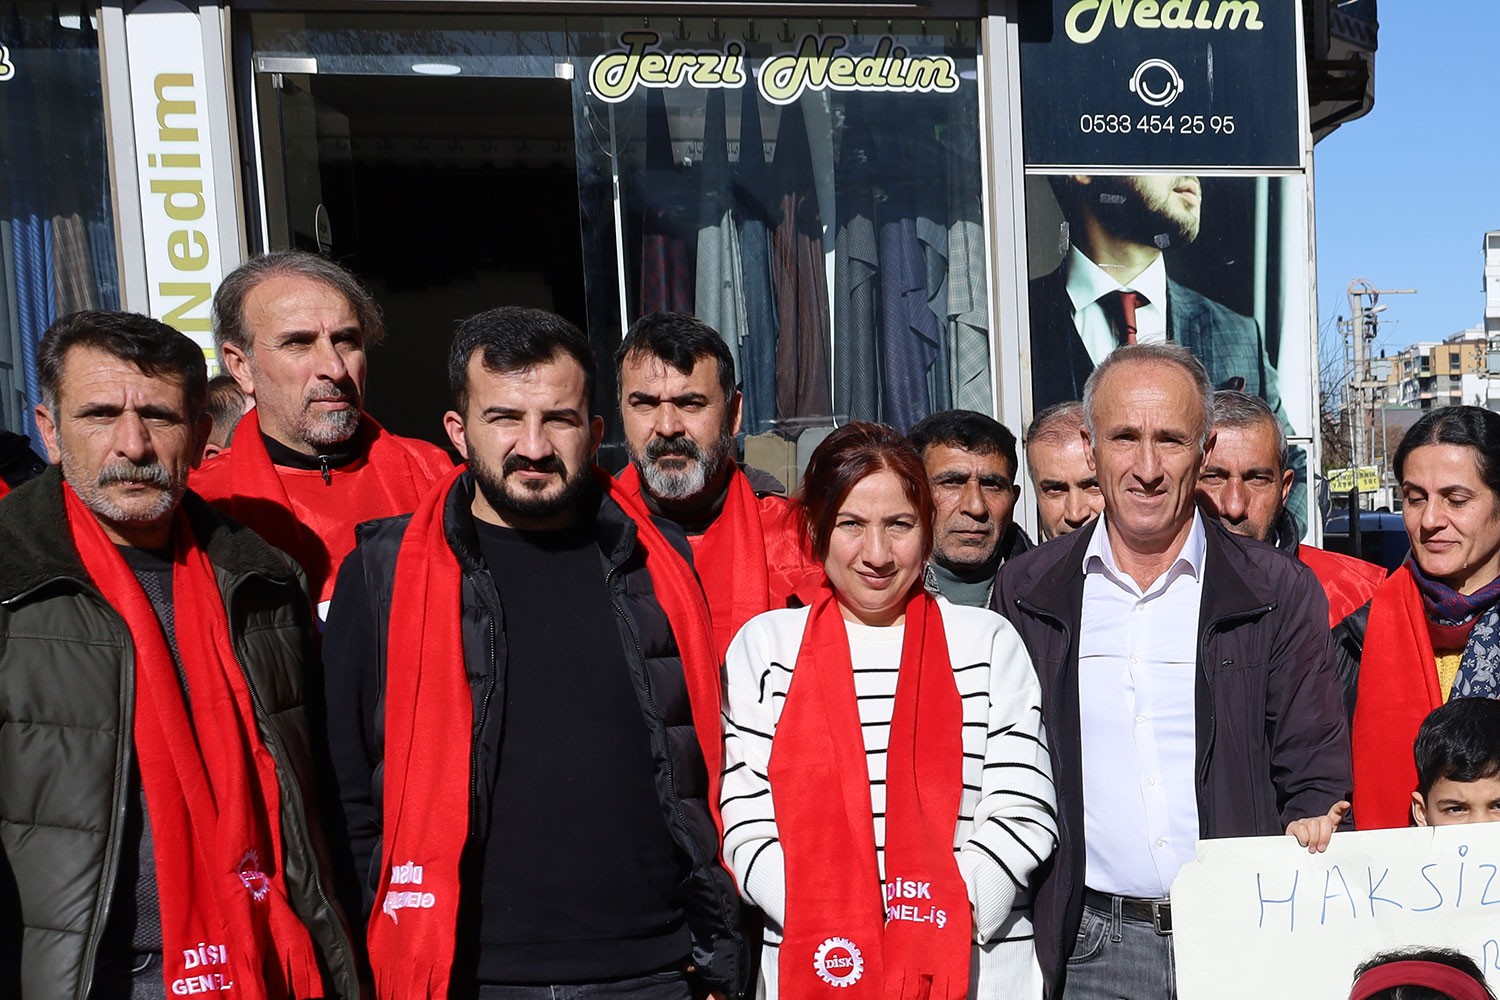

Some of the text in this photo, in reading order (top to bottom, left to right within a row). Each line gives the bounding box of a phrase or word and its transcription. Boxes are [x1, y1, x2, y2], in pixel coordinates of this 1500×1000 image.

[760, 35, 957, 103] Nedim
[1080, 114, 1235, 134] 0533 454 25 95
[148, 72, 213, 332] Nedim
[825, 954, 854, 969] DİSK
